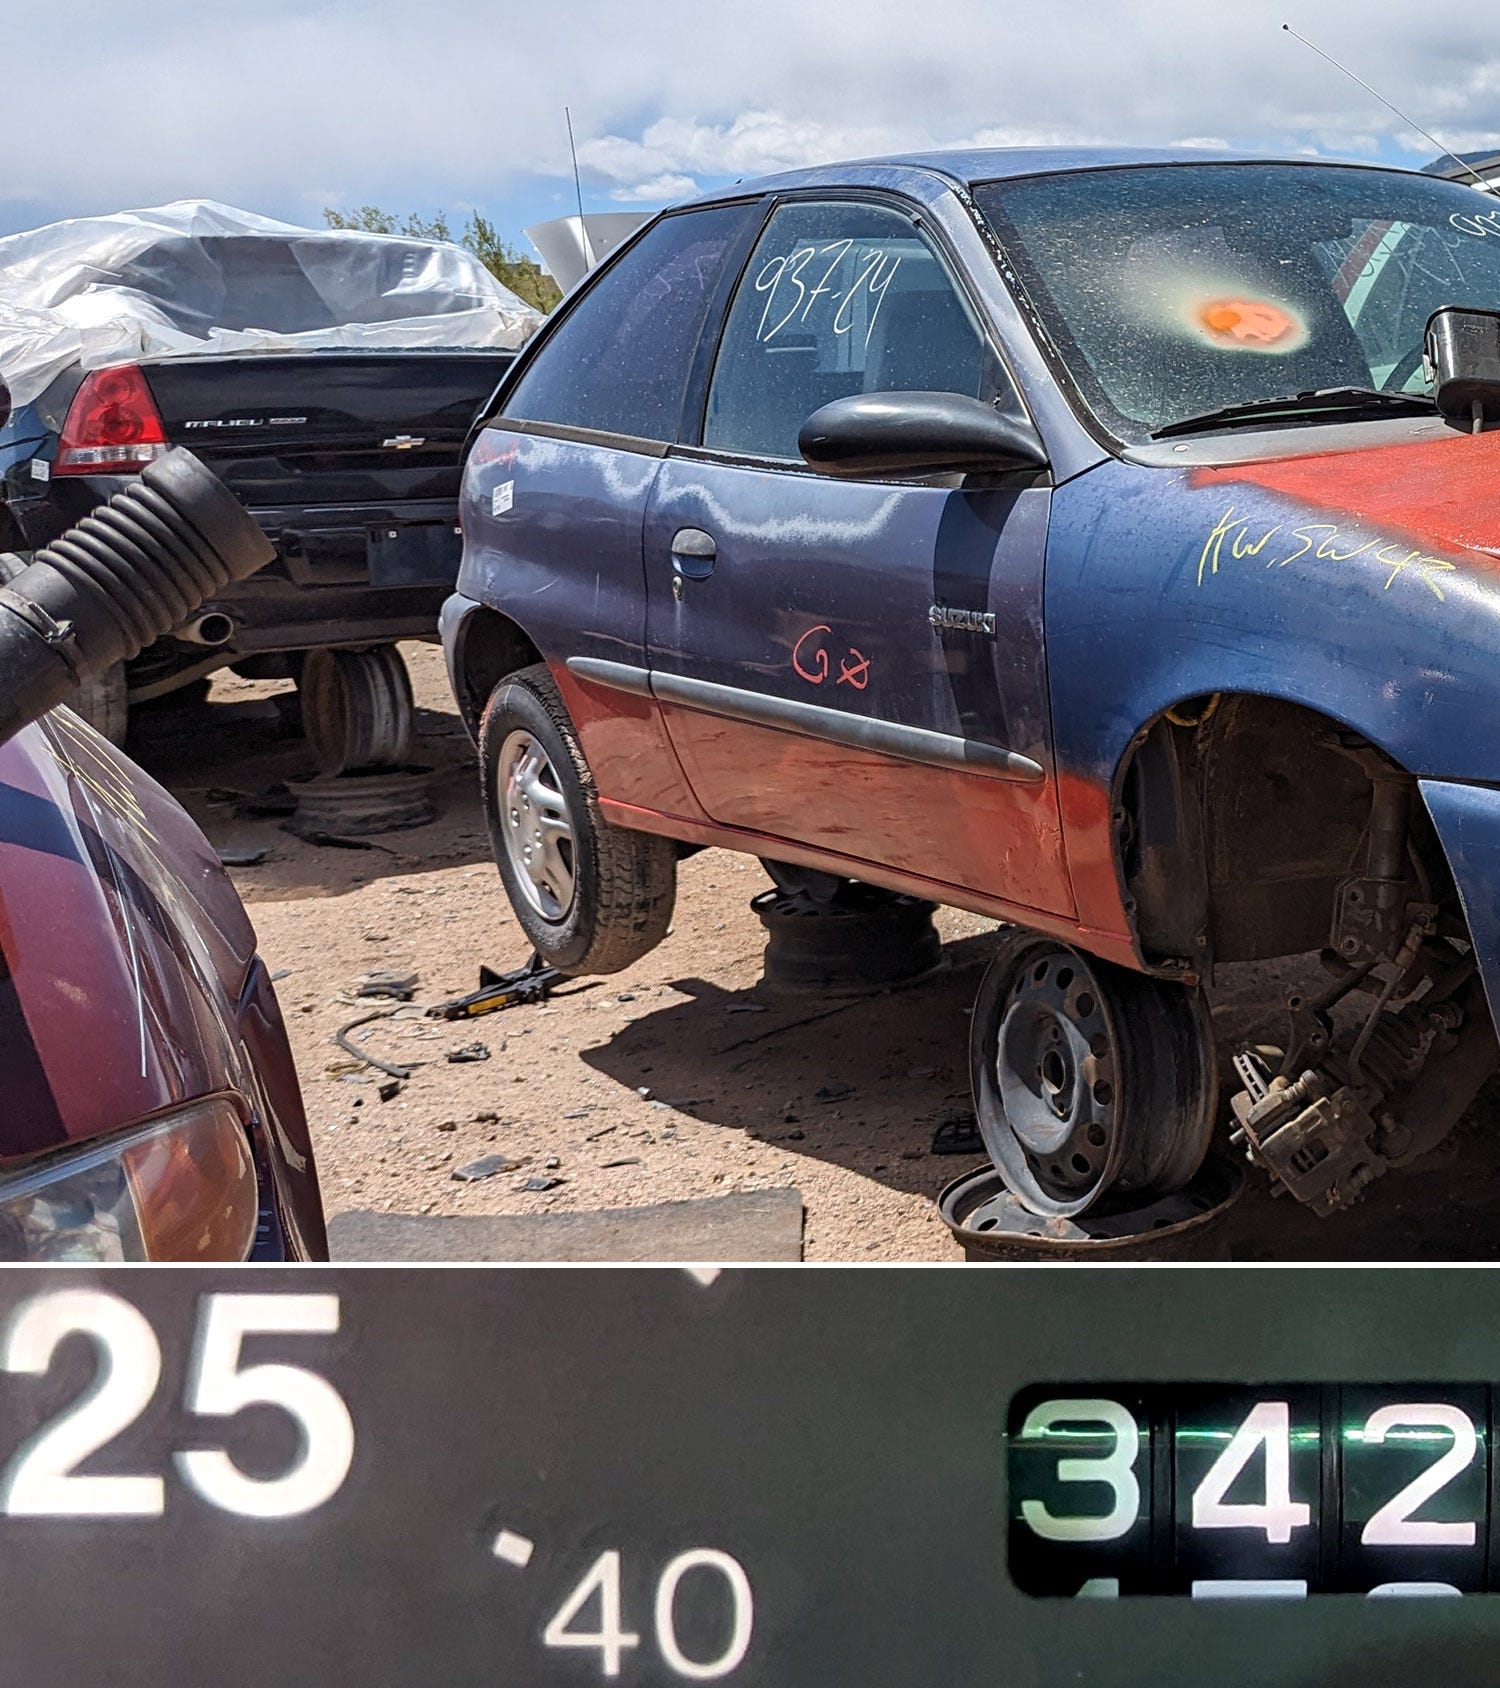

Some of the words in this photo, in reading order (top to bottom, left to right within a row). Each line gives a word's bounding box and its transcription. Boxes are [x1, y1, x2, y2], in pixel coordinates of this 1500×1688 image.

[755, 238, 902, 350] 937-24
[928, 605, 997, 635] SUZUKI
[0, 1286, 355, 1520] 25
[543, 1548, 754, 1680] 40
